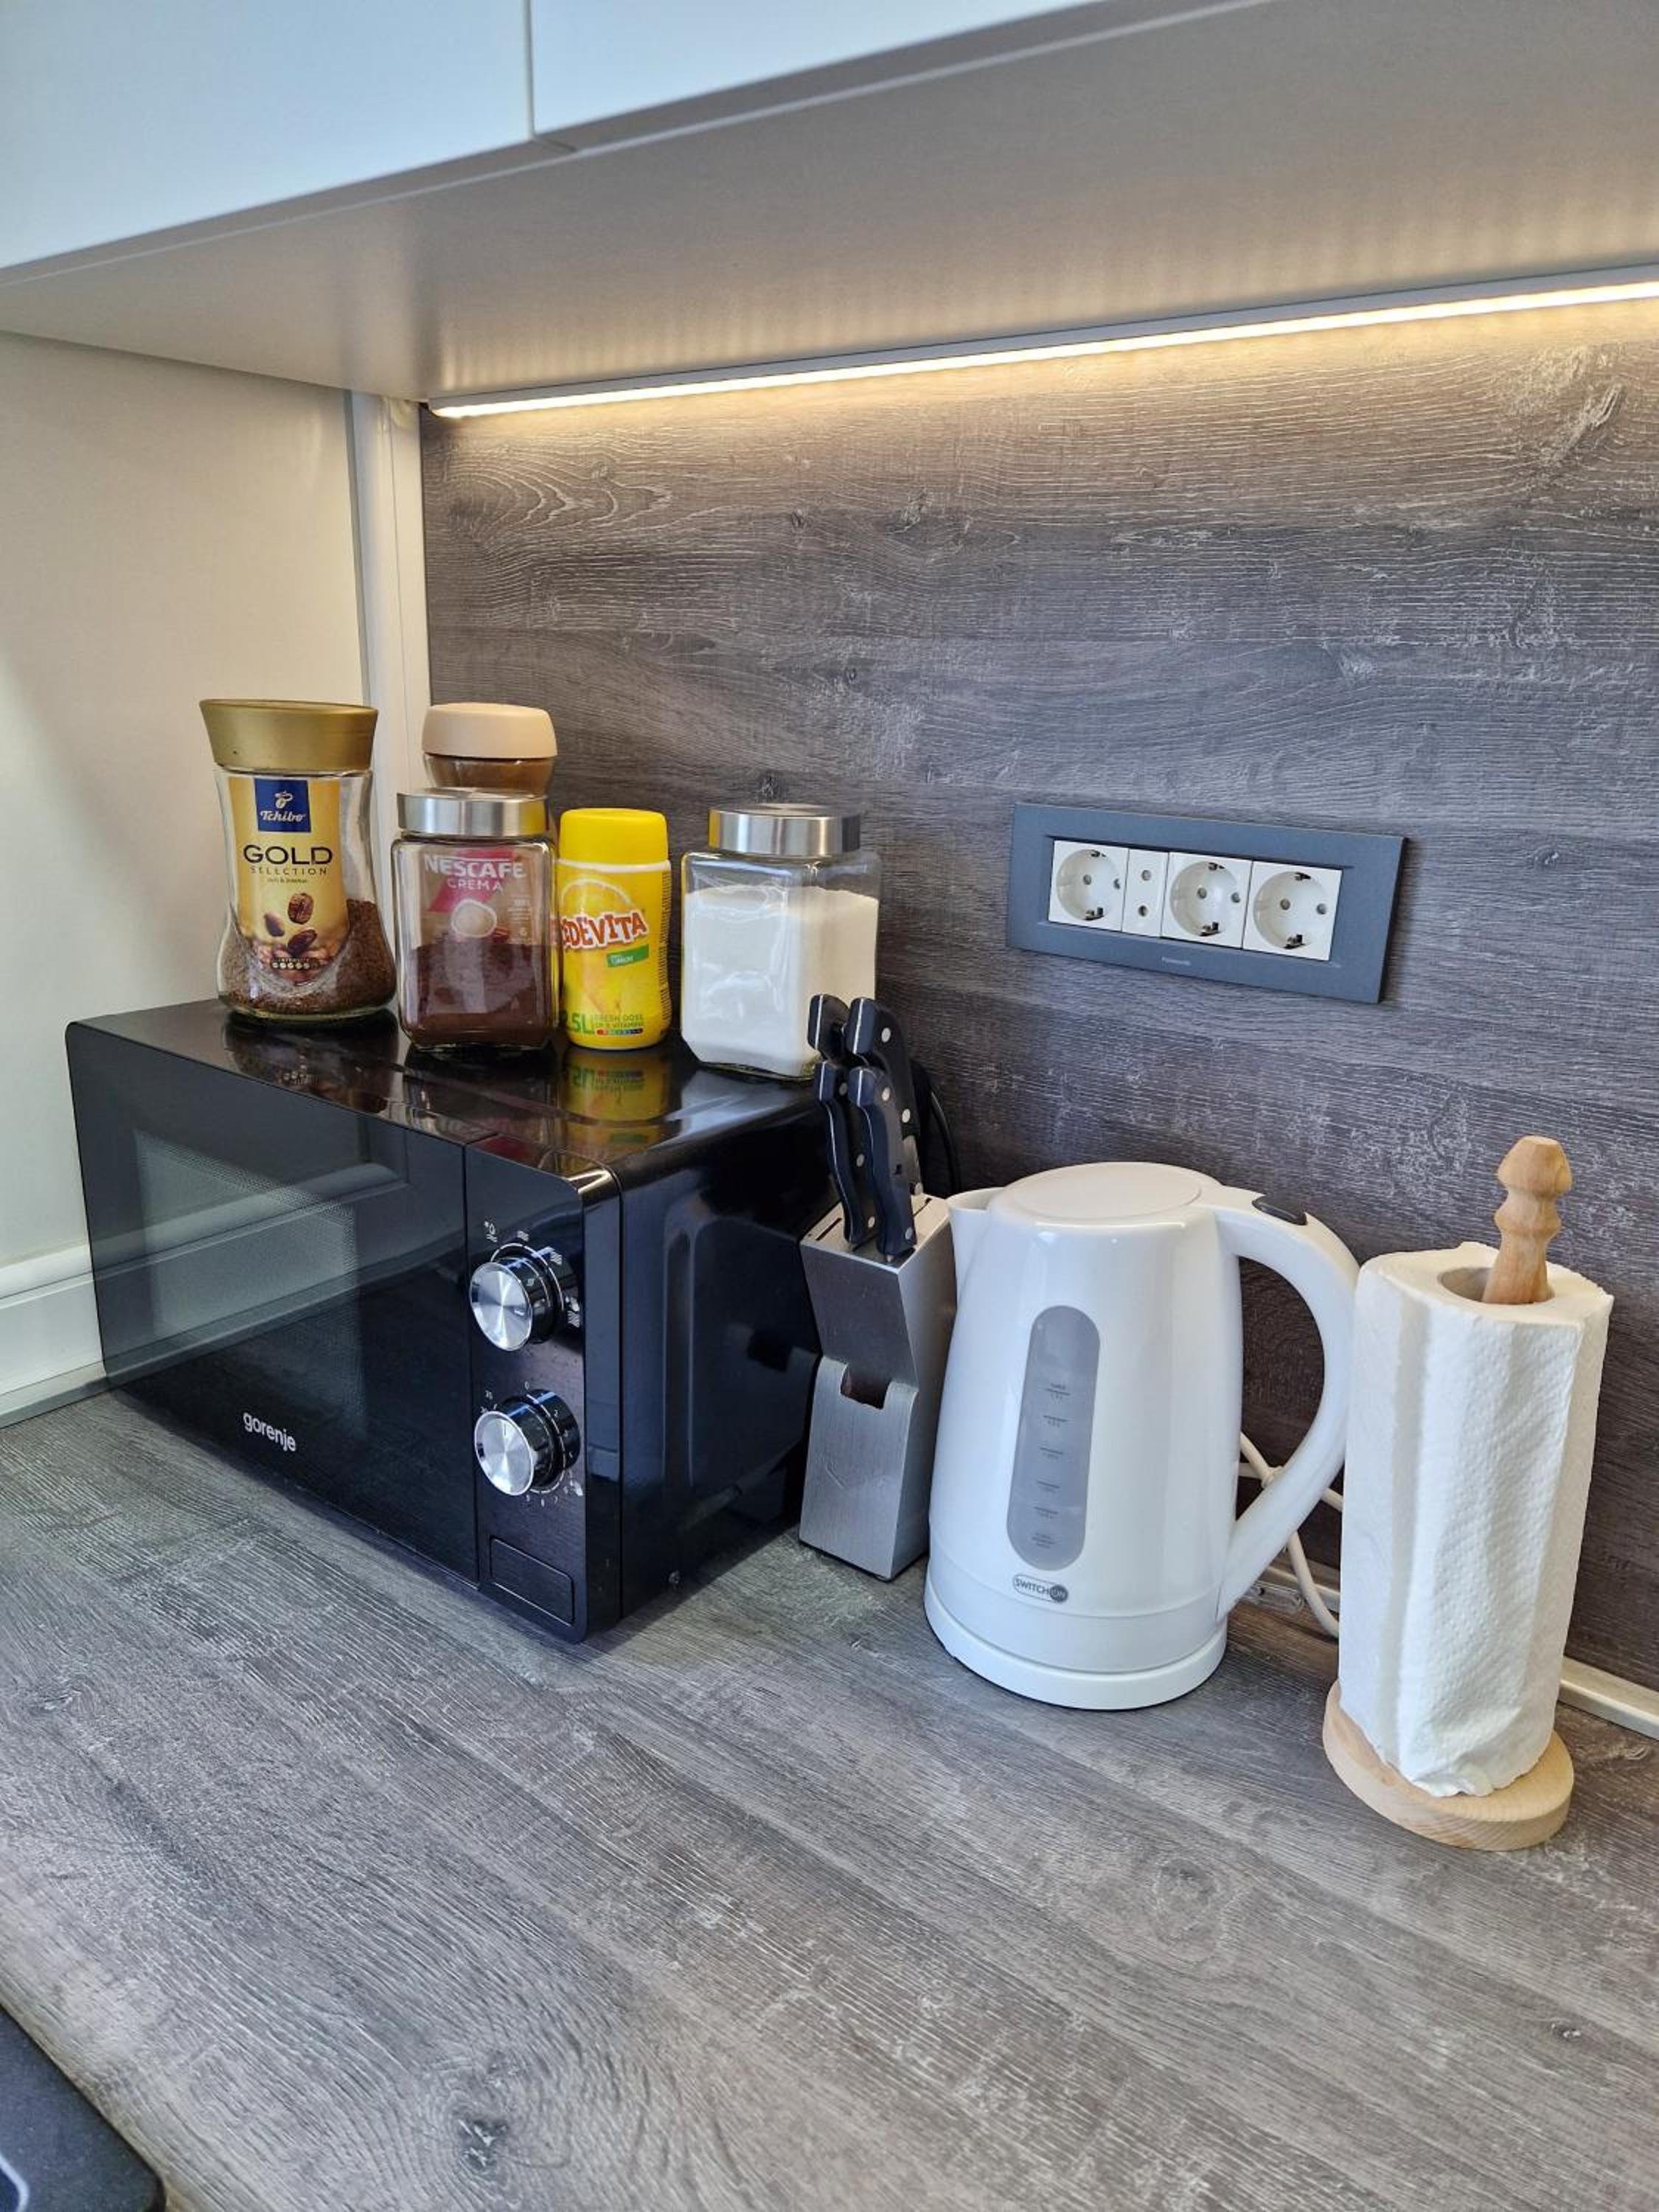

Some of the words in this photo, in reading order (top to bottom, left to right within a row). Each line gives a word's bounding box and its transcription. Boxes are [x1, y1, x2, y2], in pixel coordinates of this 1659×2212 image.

[260, 810, 306, 822] Tchibo
[243, 844, 334, 865] GOLD
[249, 866, 327, 875] SELECTION
[447, 877, 504, 891] CREMA
[243, 1412, 296, 1452] gorenje
[1015, 1578, 1050, 1596] SWITCH
